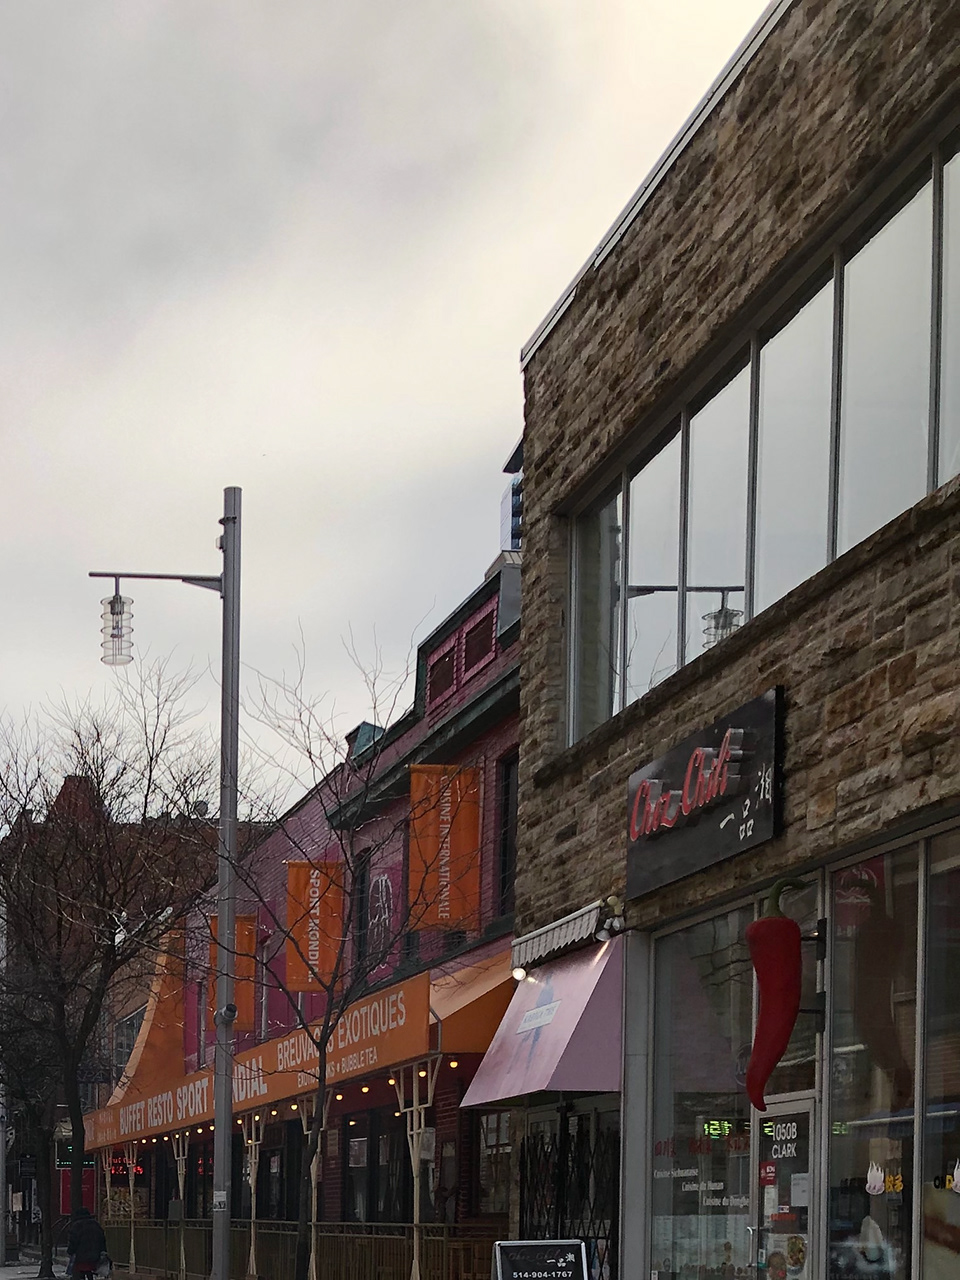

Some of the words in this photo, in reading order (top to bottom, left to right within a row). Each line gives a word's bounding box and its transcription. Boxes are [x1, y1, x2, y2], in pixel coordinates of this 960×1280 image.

[308, 869, 321, 917] SPORT
[277, 1026, 334, 1071] BREUVAGS
[339, 990, 406, 1050] EXOTIQUES
[341, 1051, 365, 1074] BUBBLE
[365, 1046, 378, 1065] TEA
[120, 1100, 145, 1136] BUFFET
[147, 1090, 174, 1128] RESTO
[176, 1077, 209, 1121] SPORT
[772, 1122, 798, 1142] 1050B
[771, 1142, 797, 1159] CLARK
[513, 1271, 573, 1279] 514-904-1767
